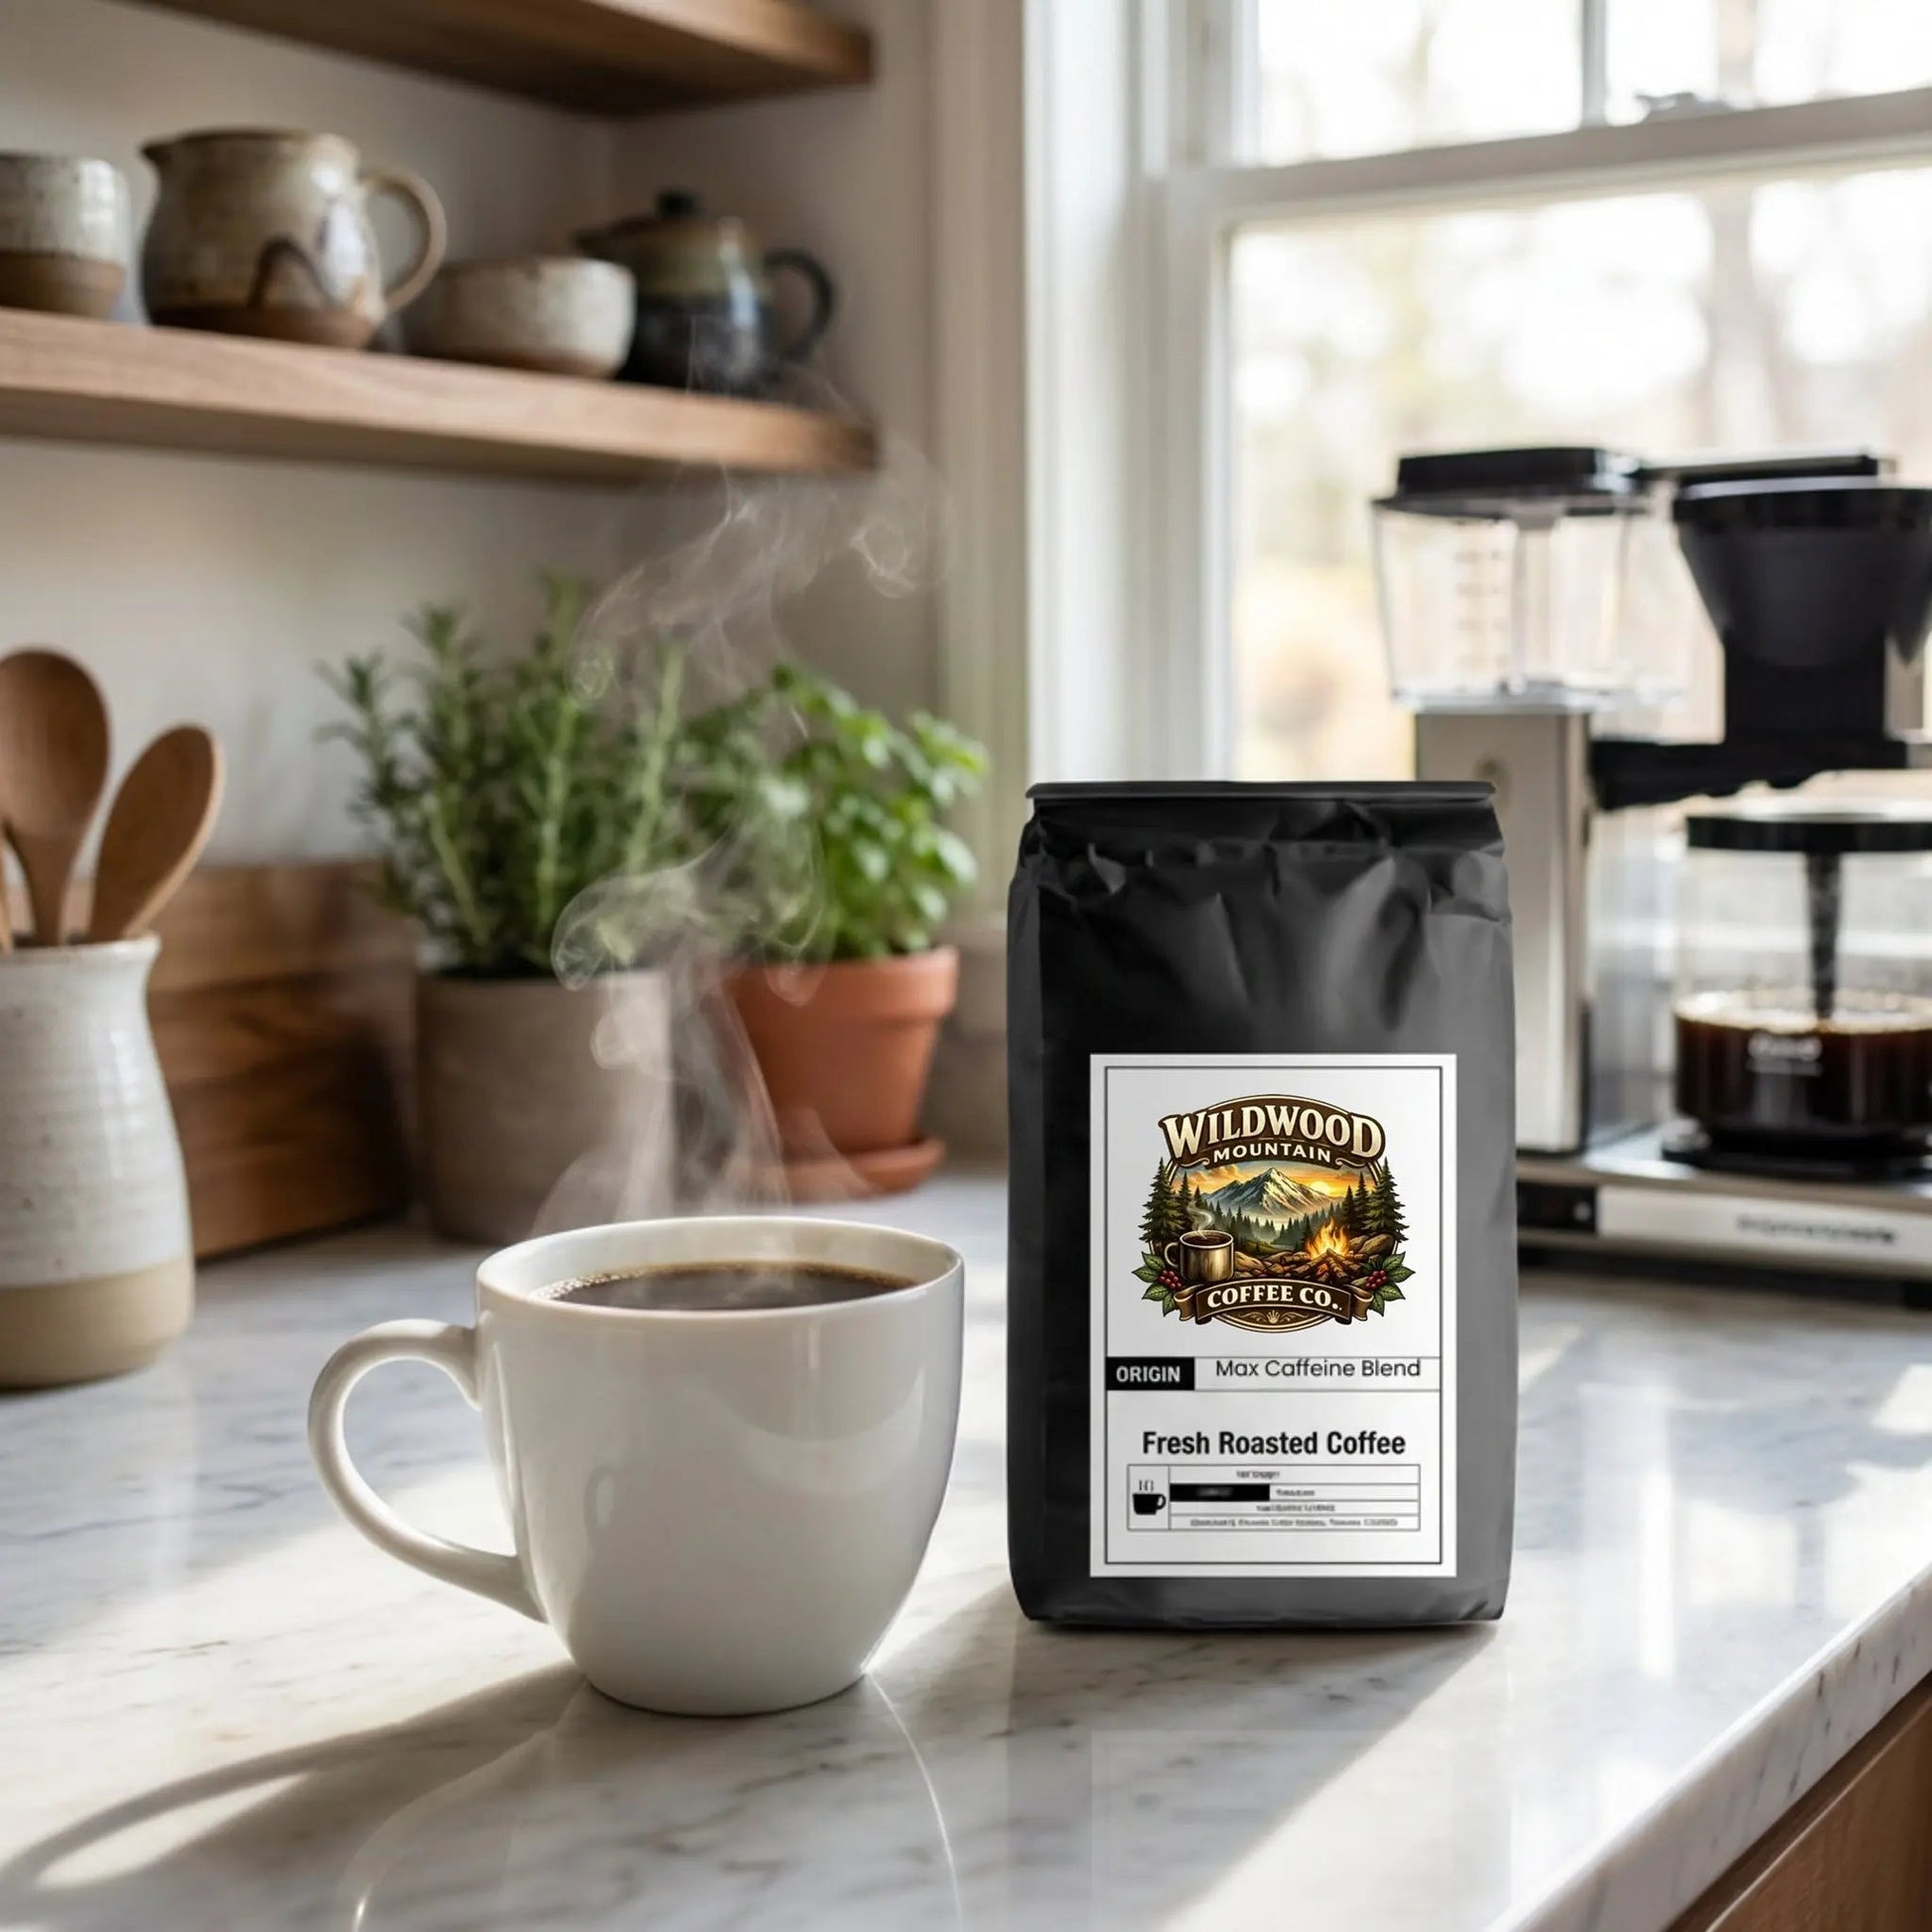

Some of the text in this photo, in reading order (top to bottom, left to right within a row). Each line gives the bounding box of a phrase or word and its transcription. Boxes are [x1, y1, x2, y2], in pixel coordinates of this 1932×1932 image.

[1163, 1104, 1383, 1160] WILDWOOD
[1213, 1143, 1331, 1164] MOUNTAIN
[1206, 1285, 1294, 1309] COFFEE
[1116, 1365, 1181, 1383] ORIGIN
[1215, 1358, 1422, 1377] Max Caffeine Blend
[1142, 1431, 1406, 1454] Fresh Roasted Coffee
